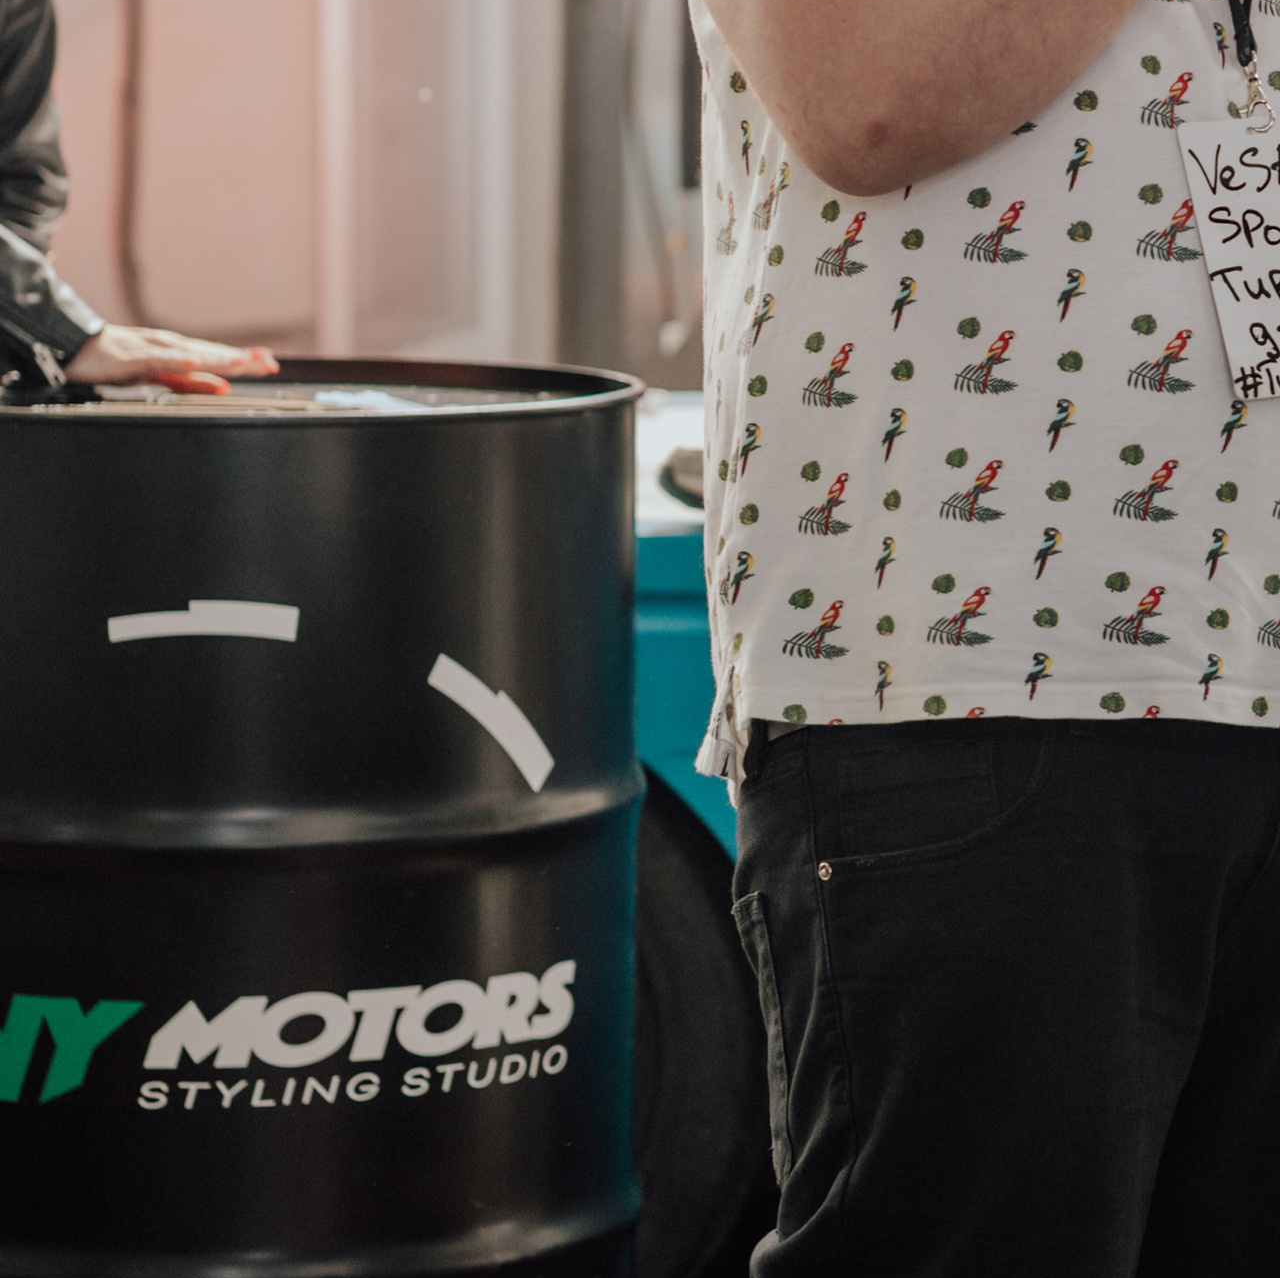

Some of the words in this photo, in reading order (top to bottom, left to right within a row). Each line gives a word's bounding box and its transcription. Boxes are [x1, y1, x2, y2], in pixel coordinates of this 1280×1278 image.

[142, 959, 577, 1071] MOTORS
[137, 1071, 381, 1111] STYLING
[401, 1043, 569, 1098] STUDIO
